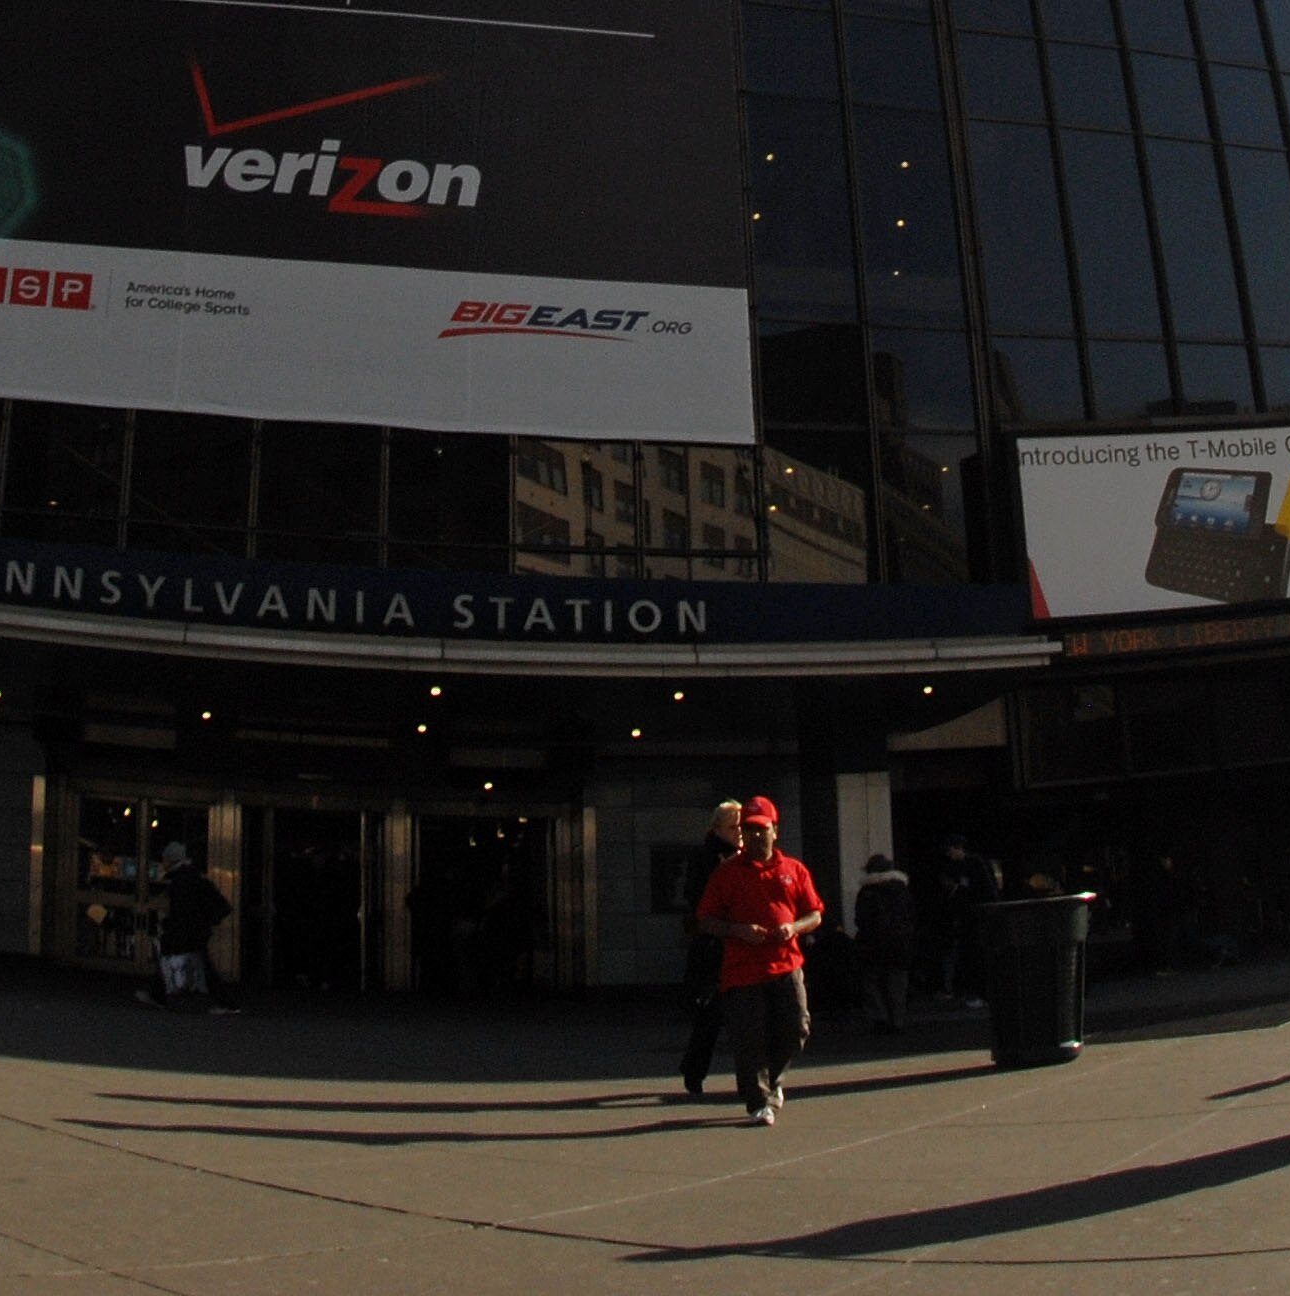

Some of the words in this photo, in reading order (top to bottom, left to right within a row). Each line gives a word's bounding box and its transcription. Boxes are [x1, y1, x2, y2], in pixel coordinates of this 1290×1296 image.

[184, 139, 482, 216] verizon
[124, 295, 144, 310] for
[146, 297, 201, 315] College
[204, 300, 251, 317] Sports
[126, 280, 192, 298] America's
[195, 287, 236, 302] Home
[1019, 444, 1141, 467] ntroducing
[1146, 443, 1181, 461] the
[1185, 436, 1278, 459] T-Mobile
[452, 594, 709, 633] STATION
